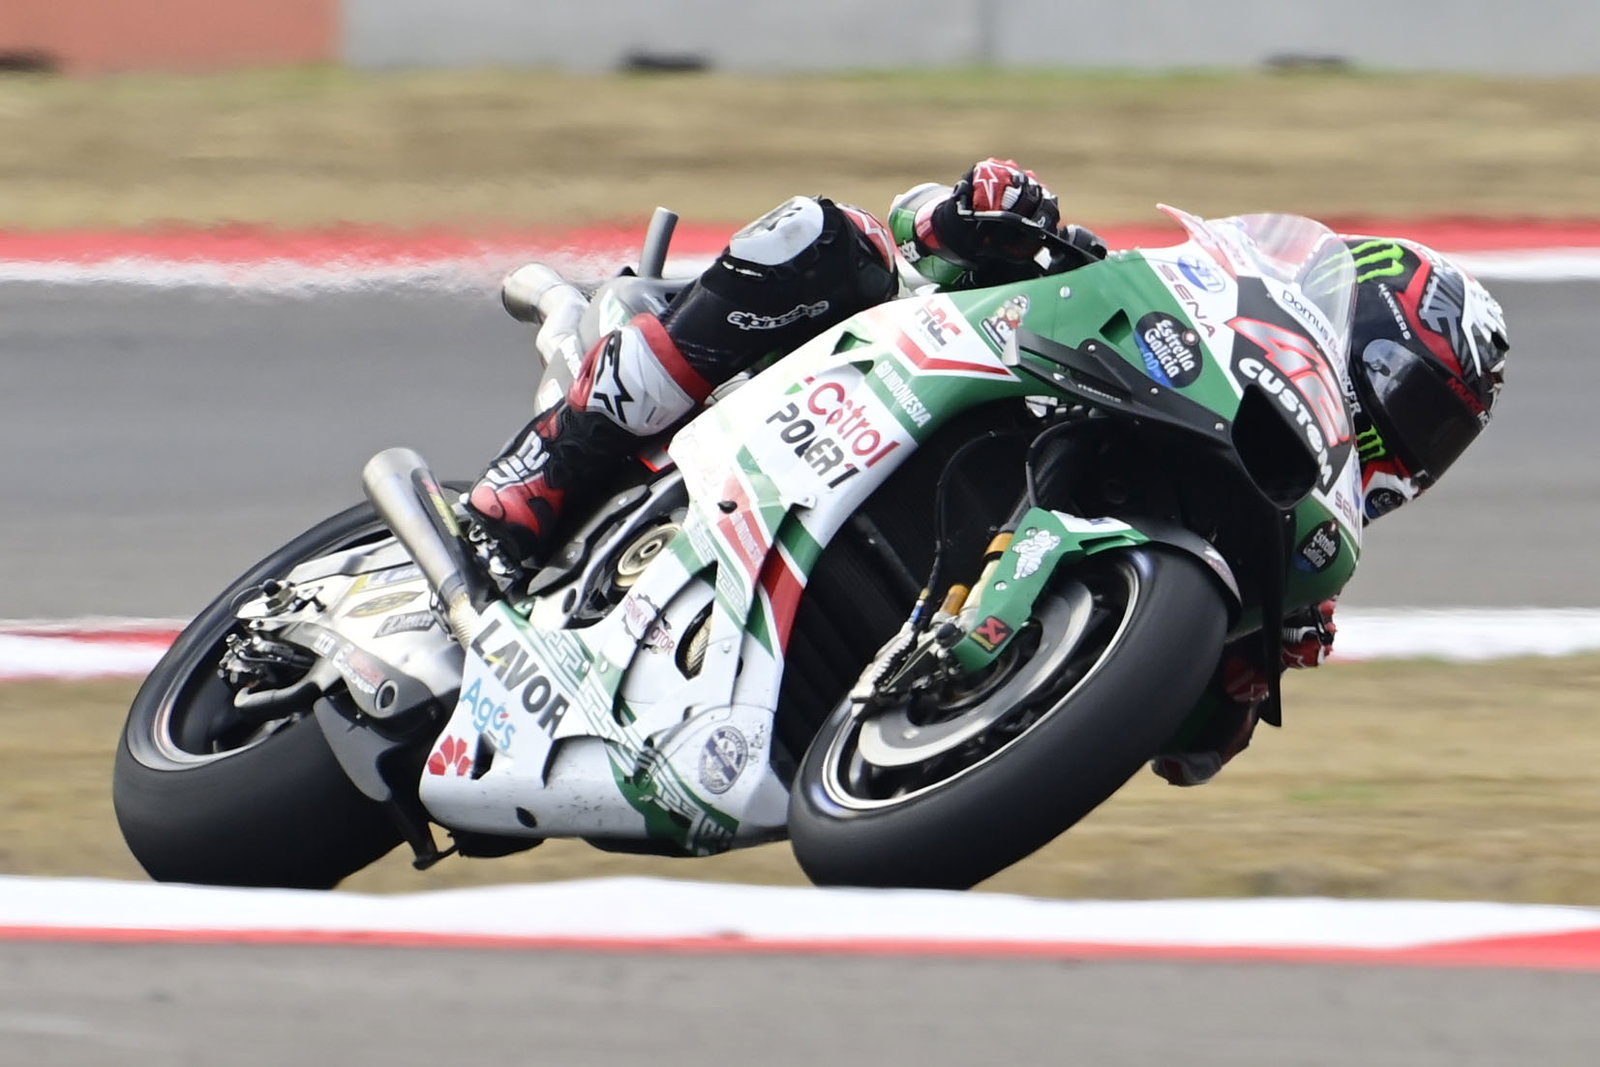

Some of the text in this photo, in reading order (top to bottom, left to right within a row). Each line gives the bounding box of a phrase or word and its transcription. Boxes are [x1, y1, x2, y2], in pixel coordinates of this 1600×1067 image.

[915, 299, 962, 346] HRC
[1158, 264, 1216, 338] SENA
[1378, 283, 1412, 340] HAWKERS
[1144, 328, 1180, 378] Galicia
[1156, 319, 1196, 372] Estrella
[884, 368, 932, 429] INDONESIA
[1225, 316, 1351, 448] 42
[1238, 357, 1333, 487] CUSTOM
[1313, 528, 1337, 557] Estrella
[470, 619, 570, 740] LAVOR
